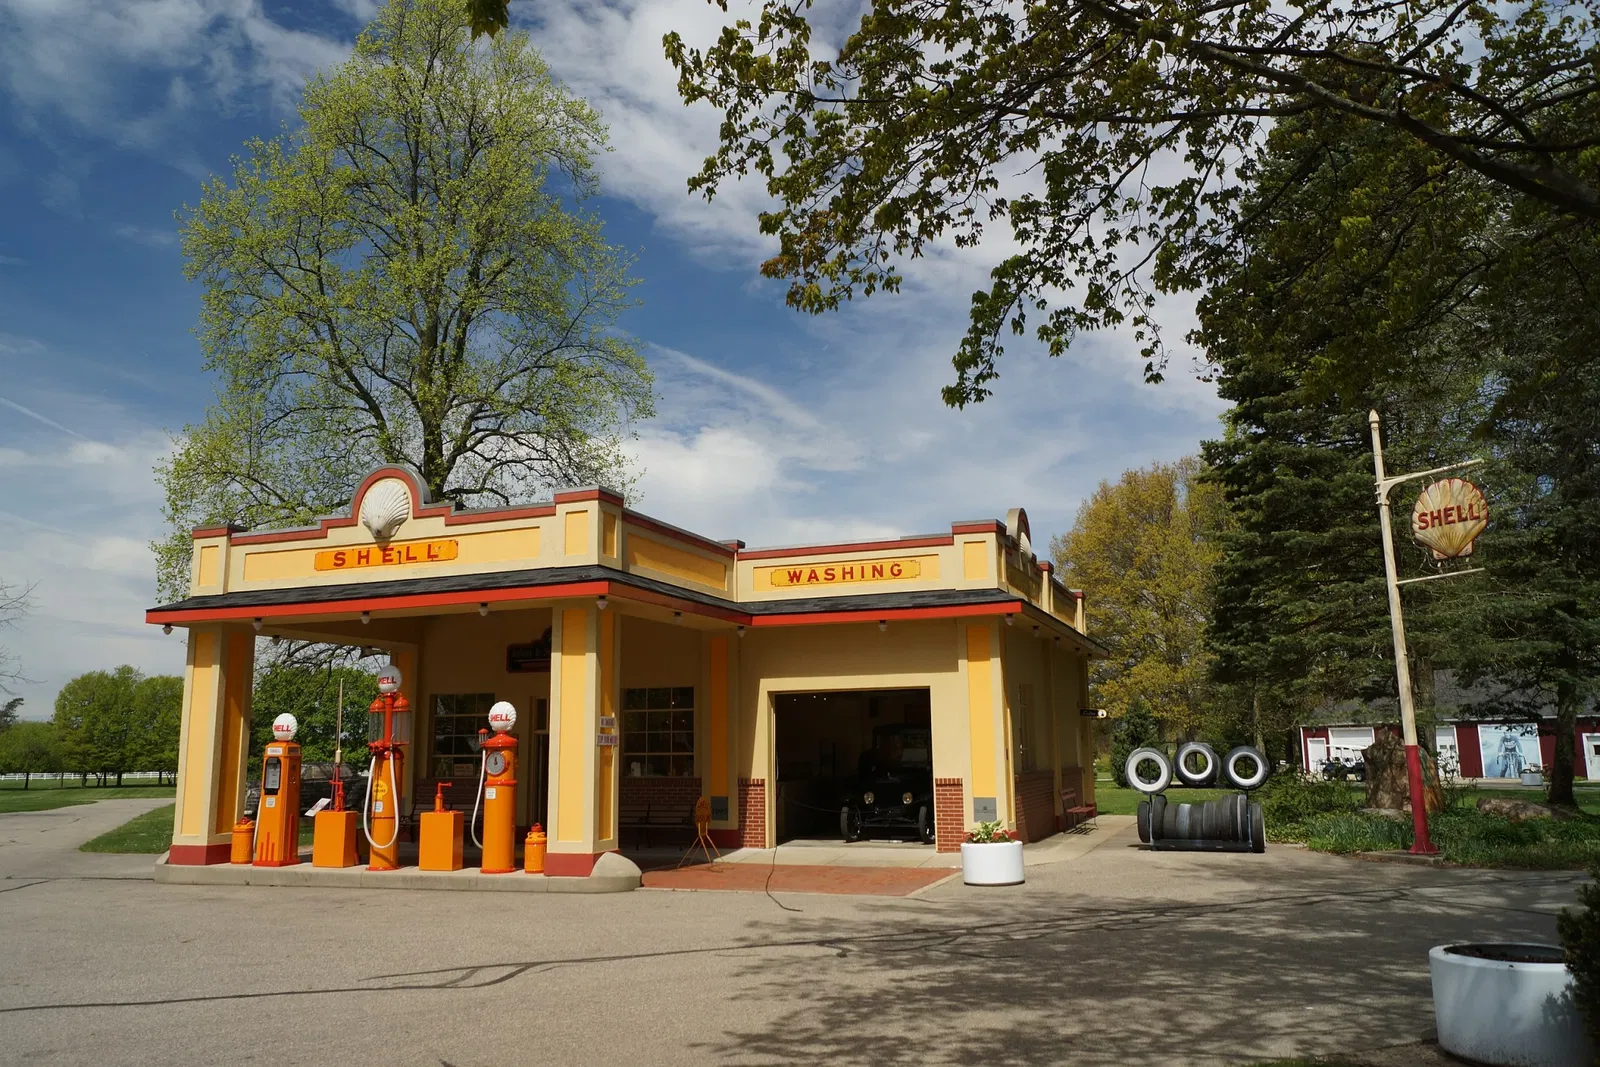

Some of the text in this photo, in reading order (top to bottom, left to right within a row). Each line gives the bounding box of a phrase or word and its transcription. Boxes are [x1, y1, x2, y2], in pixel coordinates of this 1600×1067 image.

[1418, 503, 1481, 530] SHELL
[333, 543, 439, 567] SHELL
[787, 563, 902, 583] WASHING
